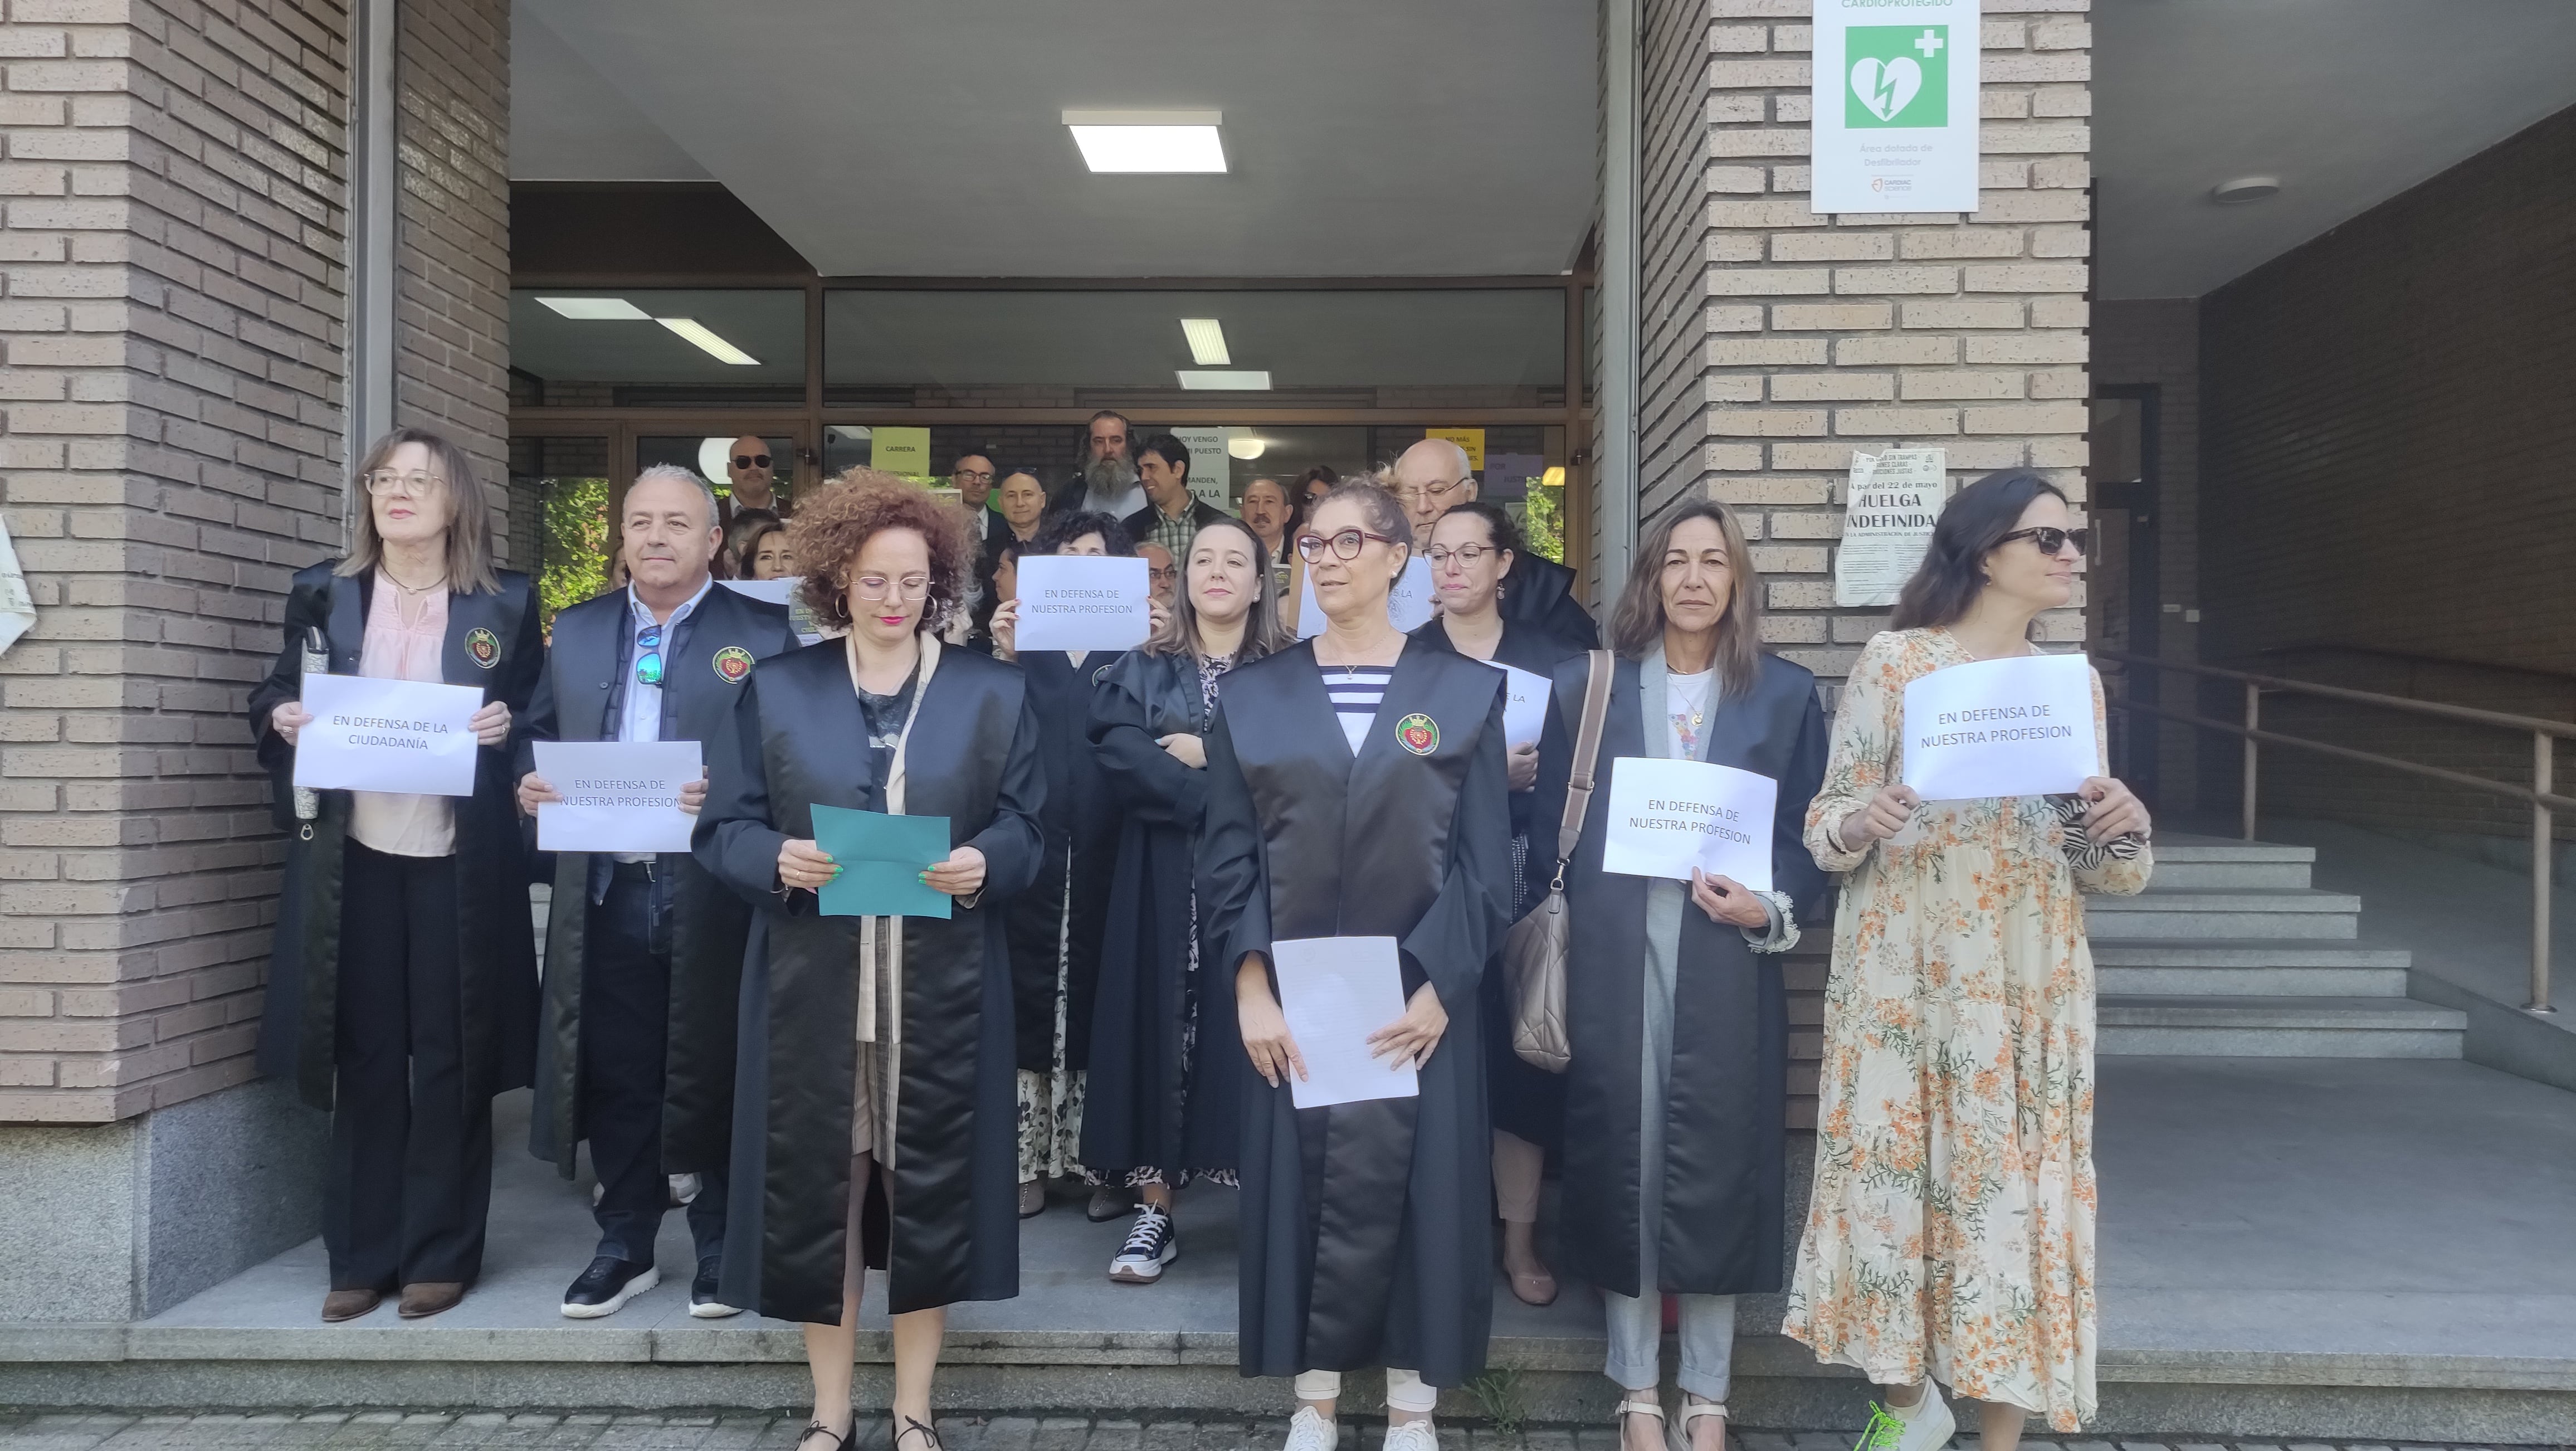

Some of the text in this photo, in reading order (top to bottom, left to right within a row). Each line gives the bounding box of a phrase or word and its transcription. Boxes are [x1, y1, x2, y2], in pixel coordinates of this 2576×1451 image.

[1841, 0, 1953, 8] CARDIOPROTEGIDO
[1858, 494, 1921, 508] HUELGA
[1847, 514, 1937, 528] NDEFINIDA
[1045, 590, 1119, 598] EN DEFENSA DE
[1031, 605, 1133, 613] NUESTRA PROFESION
[1513, 694, 1525, 703] LA
[1939, 704, 2051, 725] EN DEFENSA DE
[333, 715, 448, 734] EN DEFENSA DE LA
[348, 734, 428, 749] CIUDADANÍA
[1921, 725, 2072, 748] NUESTRA PROFESION
[575, 780, 666, 790] EN DEFENSA DE
[560, 797, 614, 806] NUESTRA
[1648, 799, 1740, 822] EN DEFENSA DE
[1629, 817, 1752, 845] NUESTRA PROFESION
